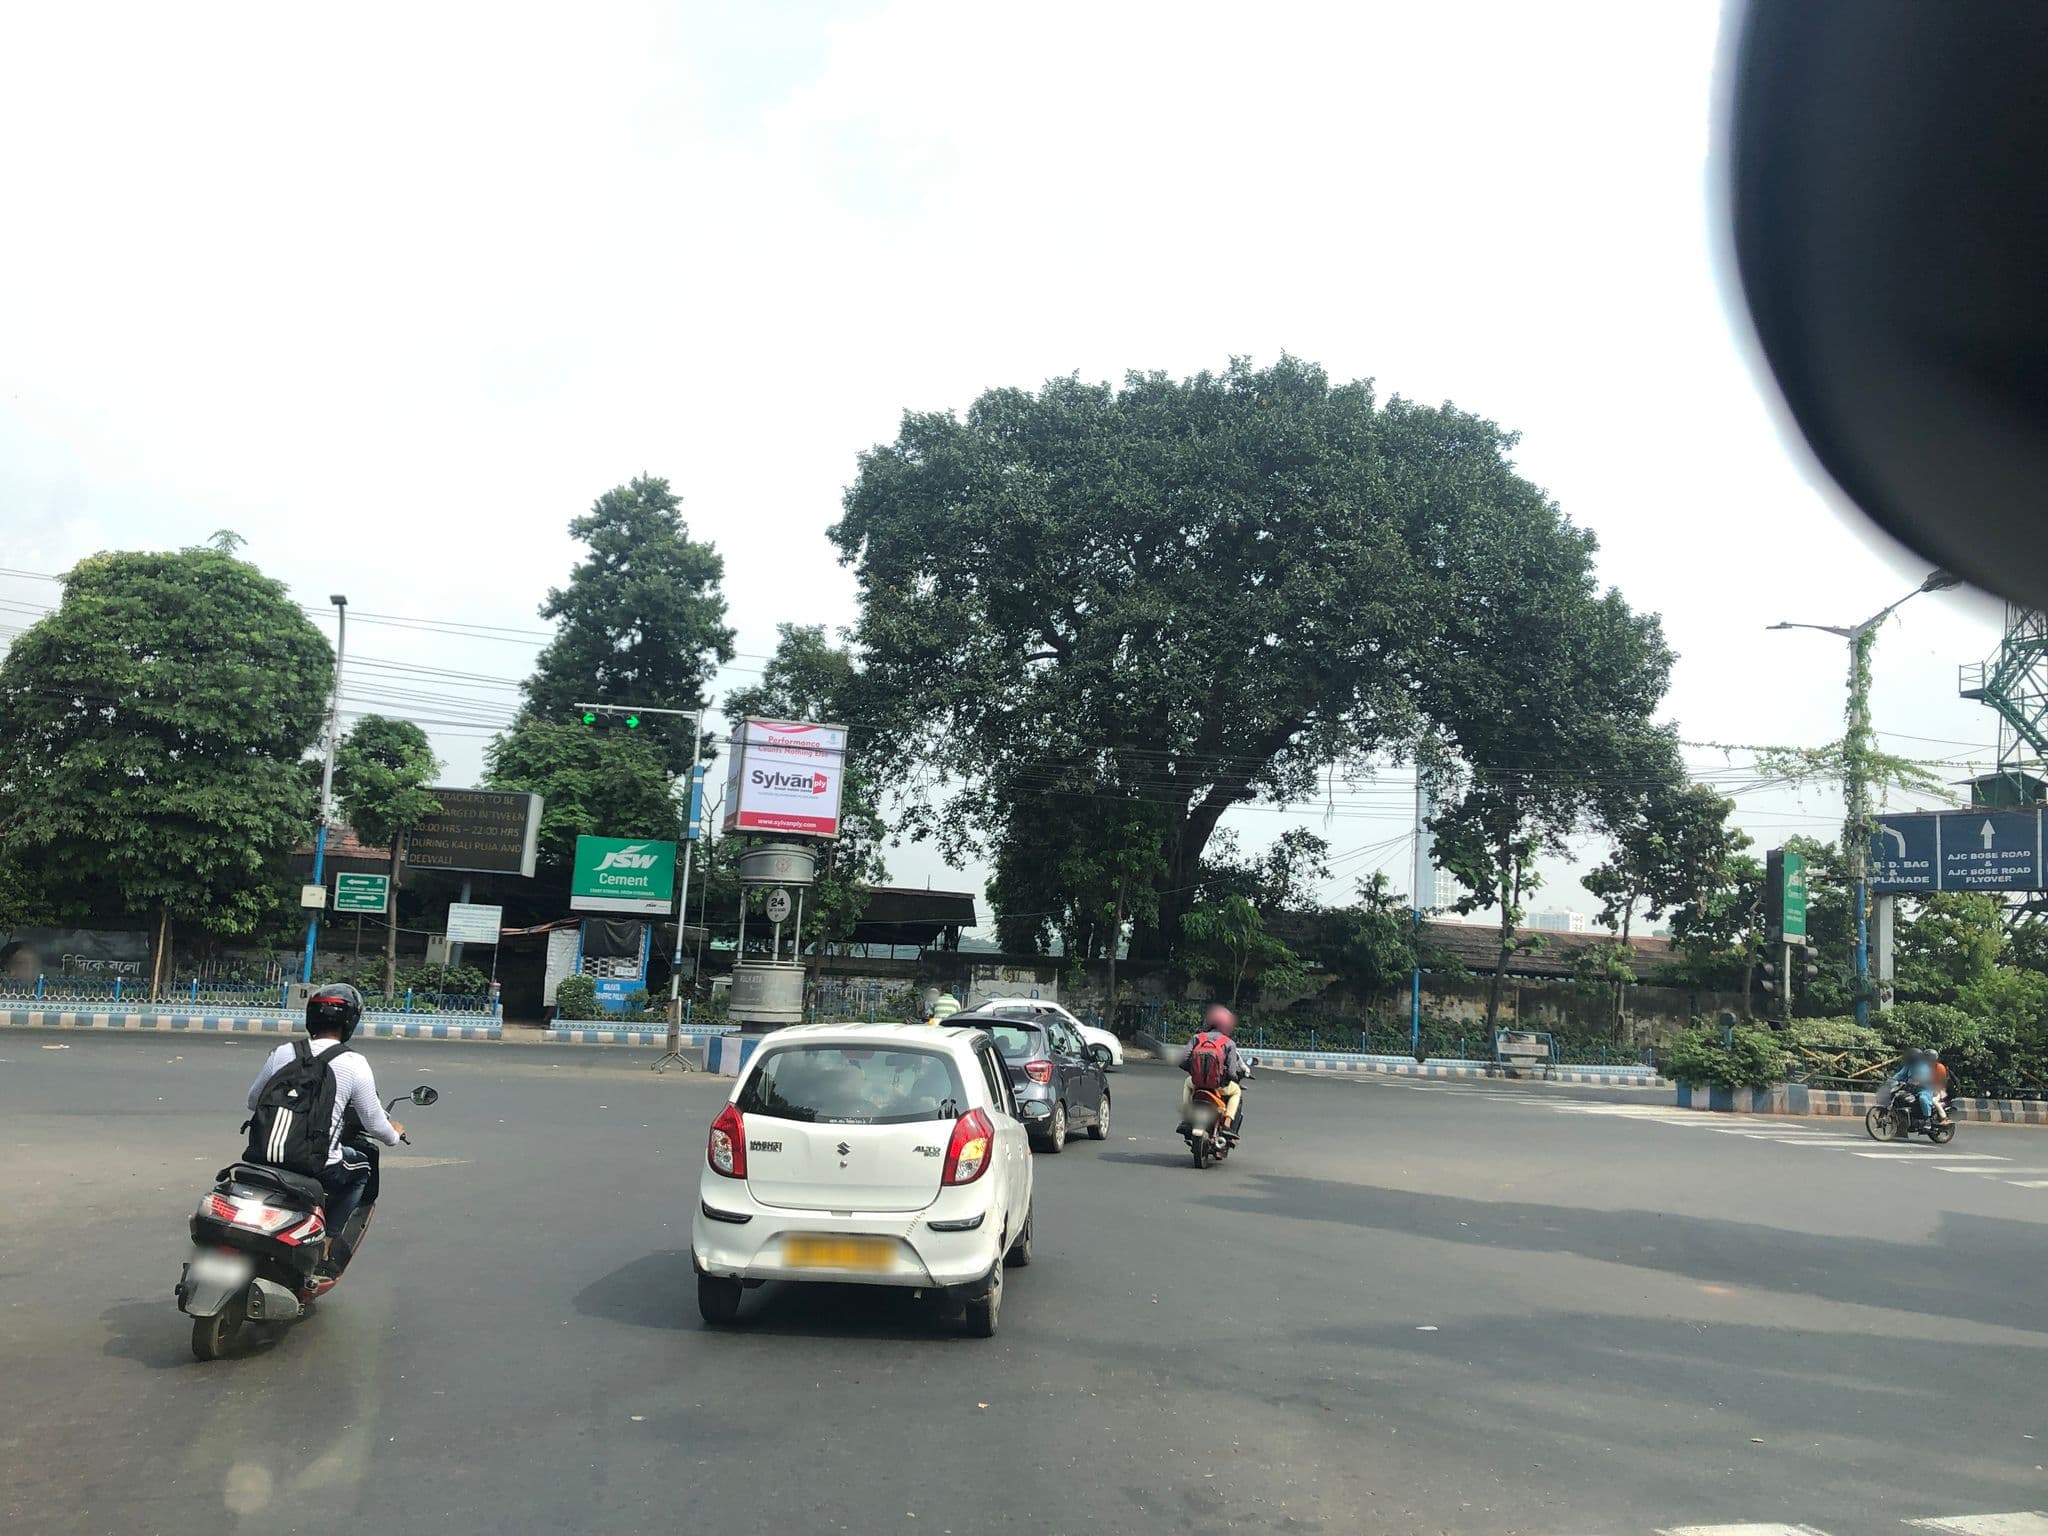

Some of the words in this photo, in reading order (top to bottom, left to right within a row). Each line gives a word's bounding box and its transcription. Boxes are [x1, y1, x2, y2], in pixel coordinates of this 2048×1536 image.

[767, 735, 820, 748] Performance
[814, 780, 827, 789] ply
[442, 823, 461, 833] HRS
[500, 827, 519, 837] HRS
[411, 838, 450, 849] DURING
[451, 840, 472, 850] KALI
[500, 844, 522, 853] AND
[409, 854, 453, 865] DEEWALI
[1970, 852, 1999, 860] BOSE
[2001, 850, 2032, 859] ROAD
[592, 851, 659, 871] JSW
[1903, 861, 1930, 869] BAG
[1970, 867, 1999, 875] BOSE
[2001, 866, 2032, 874] ROAD
[598, 872, 649, 887] Cement
[1965, 875, 2013, 884] FLYOVER
[771, 897, 786, 908] 24
